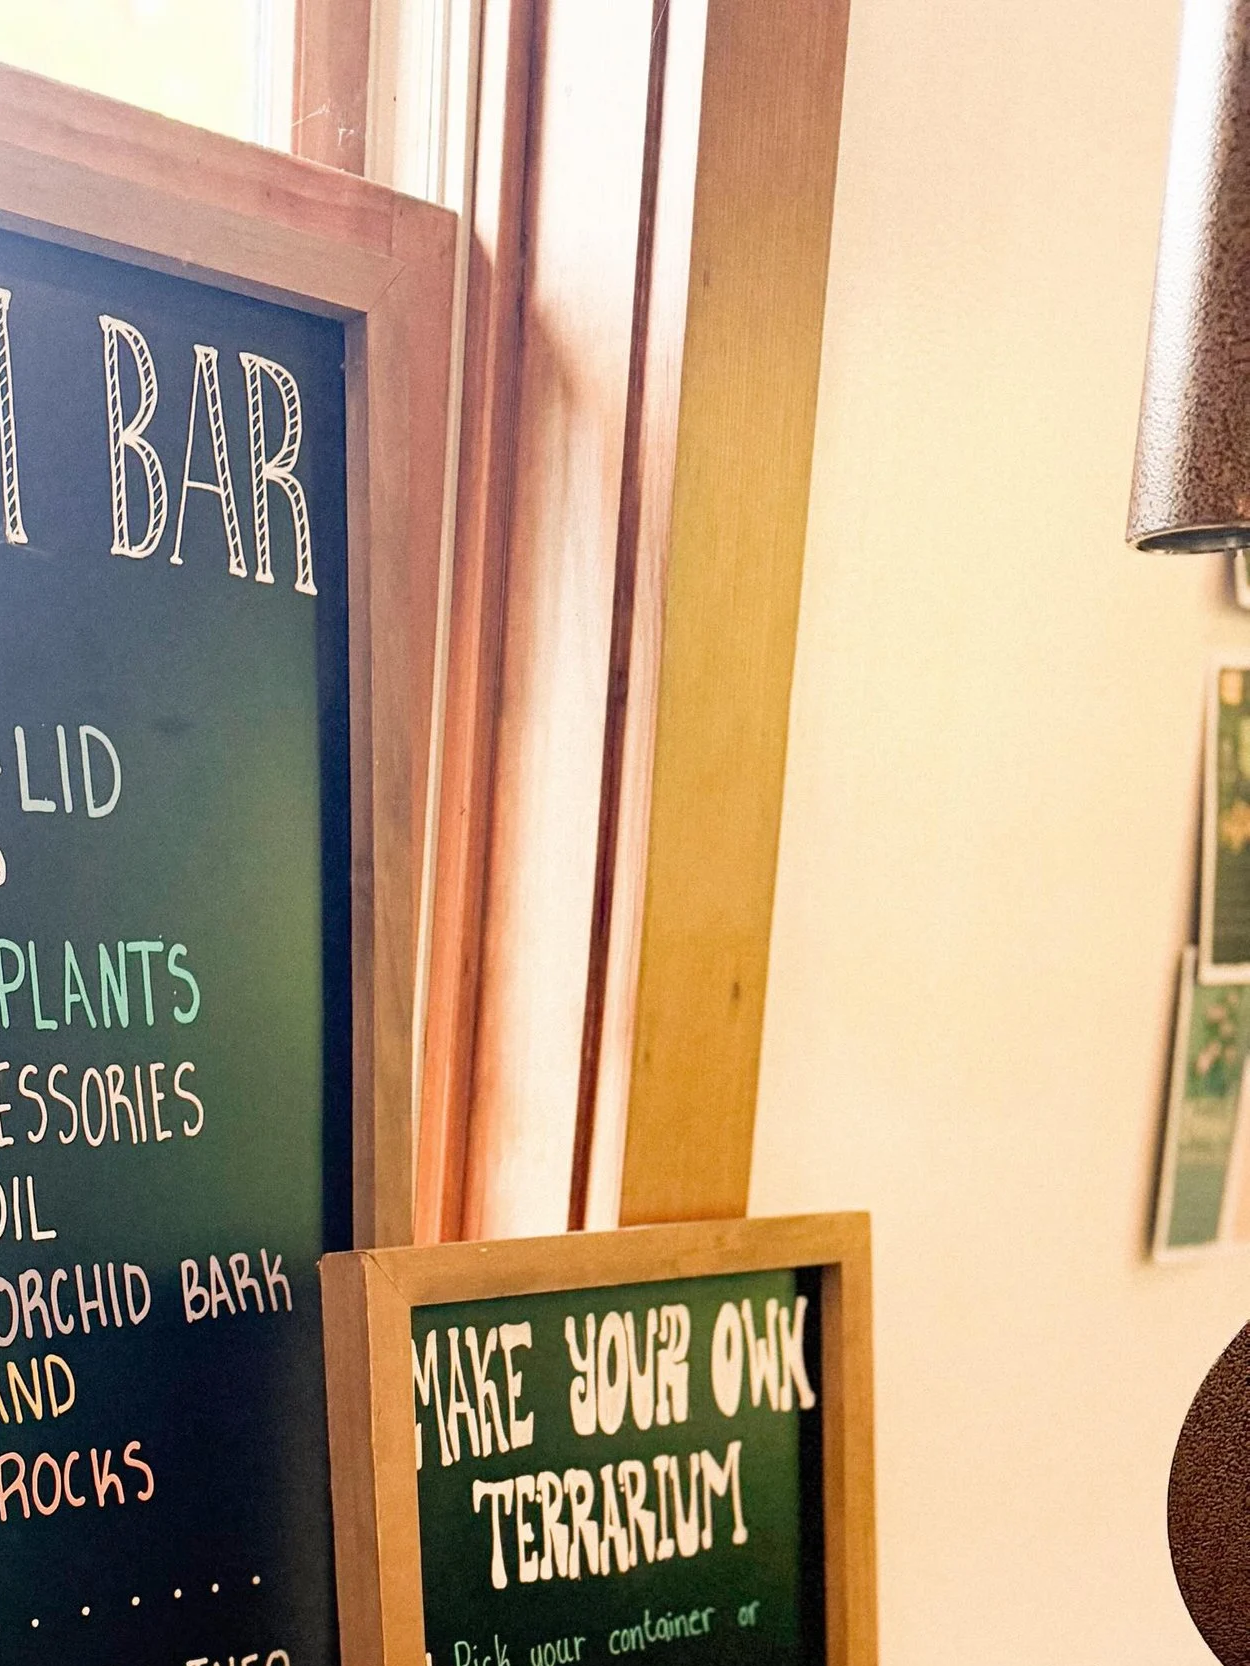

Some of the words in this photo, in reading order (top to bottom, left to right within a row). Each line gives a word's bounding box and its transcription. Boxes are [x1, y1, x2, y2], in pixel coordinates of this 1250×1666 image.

[99, 315, 318, 595] BAR
[15, 725, 123, 818] LID
[180, 1248, 293, 1324] BARK
[411, 1321, 535, 1470] MAKE
[564, 1303, 692, 1436] YOUR
[472, 1440, 749, 1590] TERRARIUM
[608, 1604, 716, 1656] container
[737, 1600, 761, 1626] or
